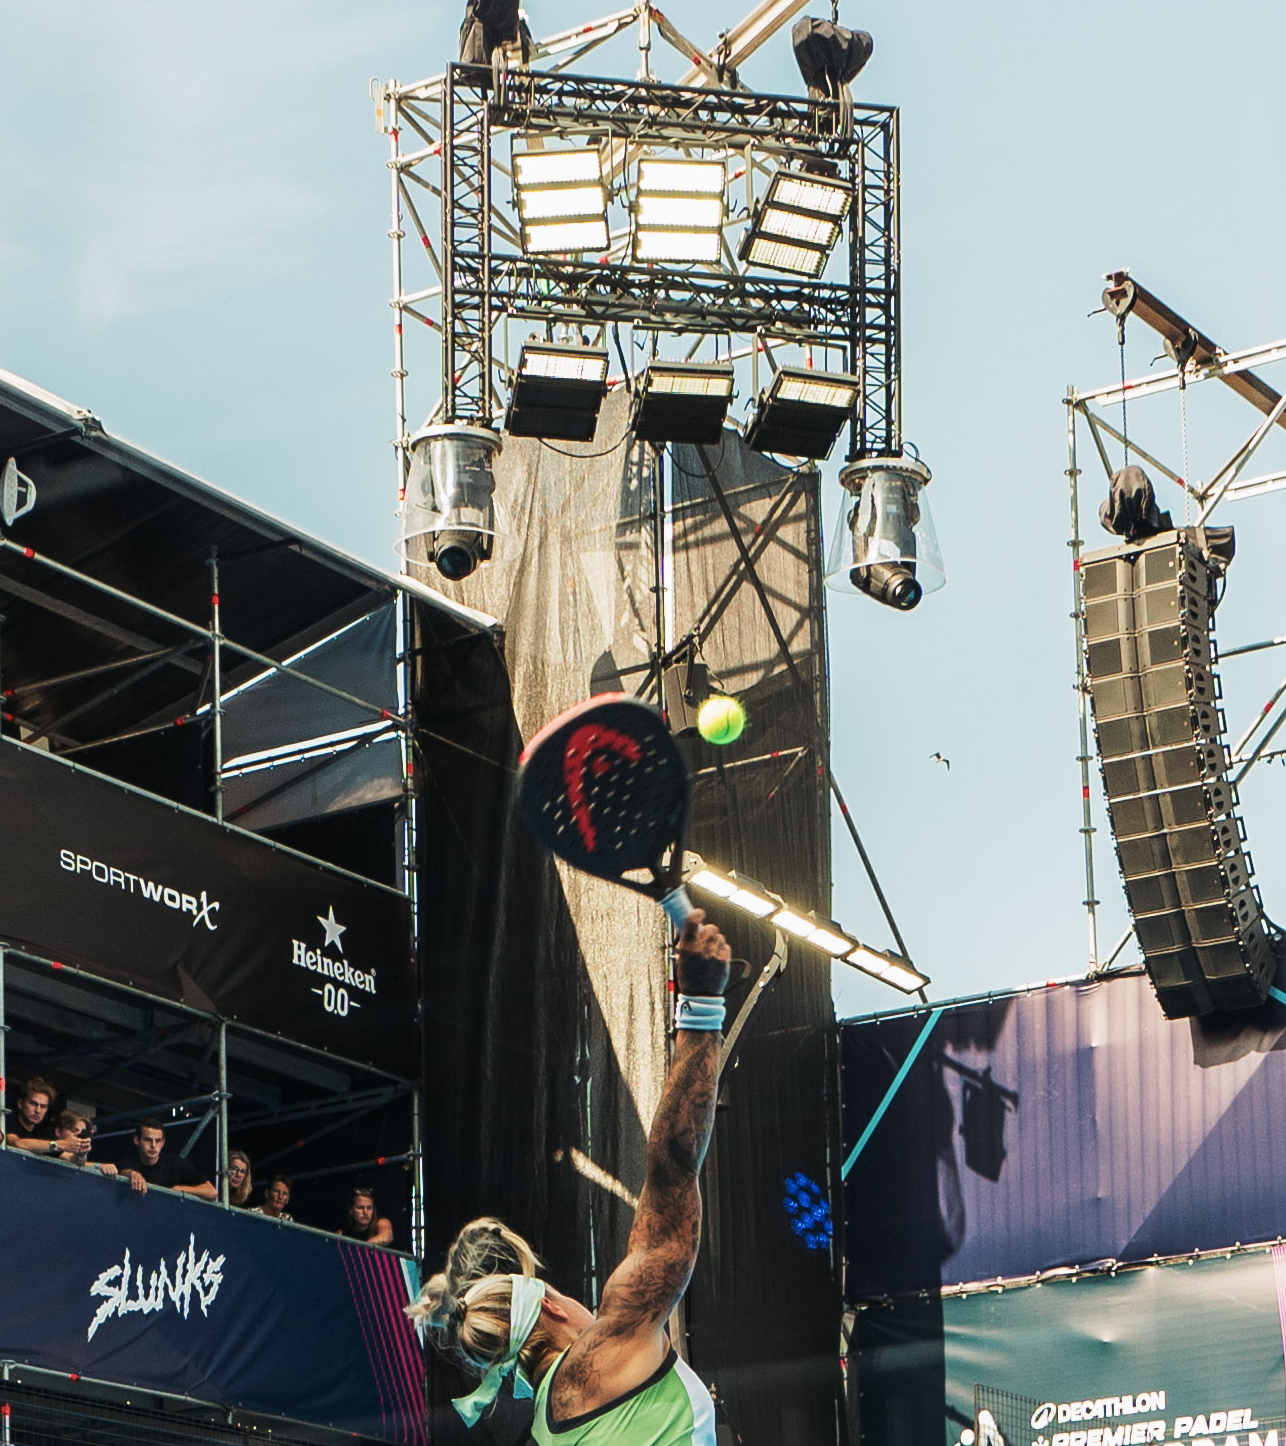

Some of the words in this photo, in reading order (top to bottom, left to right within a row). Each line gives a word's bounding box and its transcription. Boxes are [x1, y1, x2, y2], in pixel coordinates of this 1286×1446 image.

[292, 938, 376, 995] Heineken
[1057, 1391, 1165, 1423] DECATHLON
[1173, 1409, 1258, 1437] PADEL
